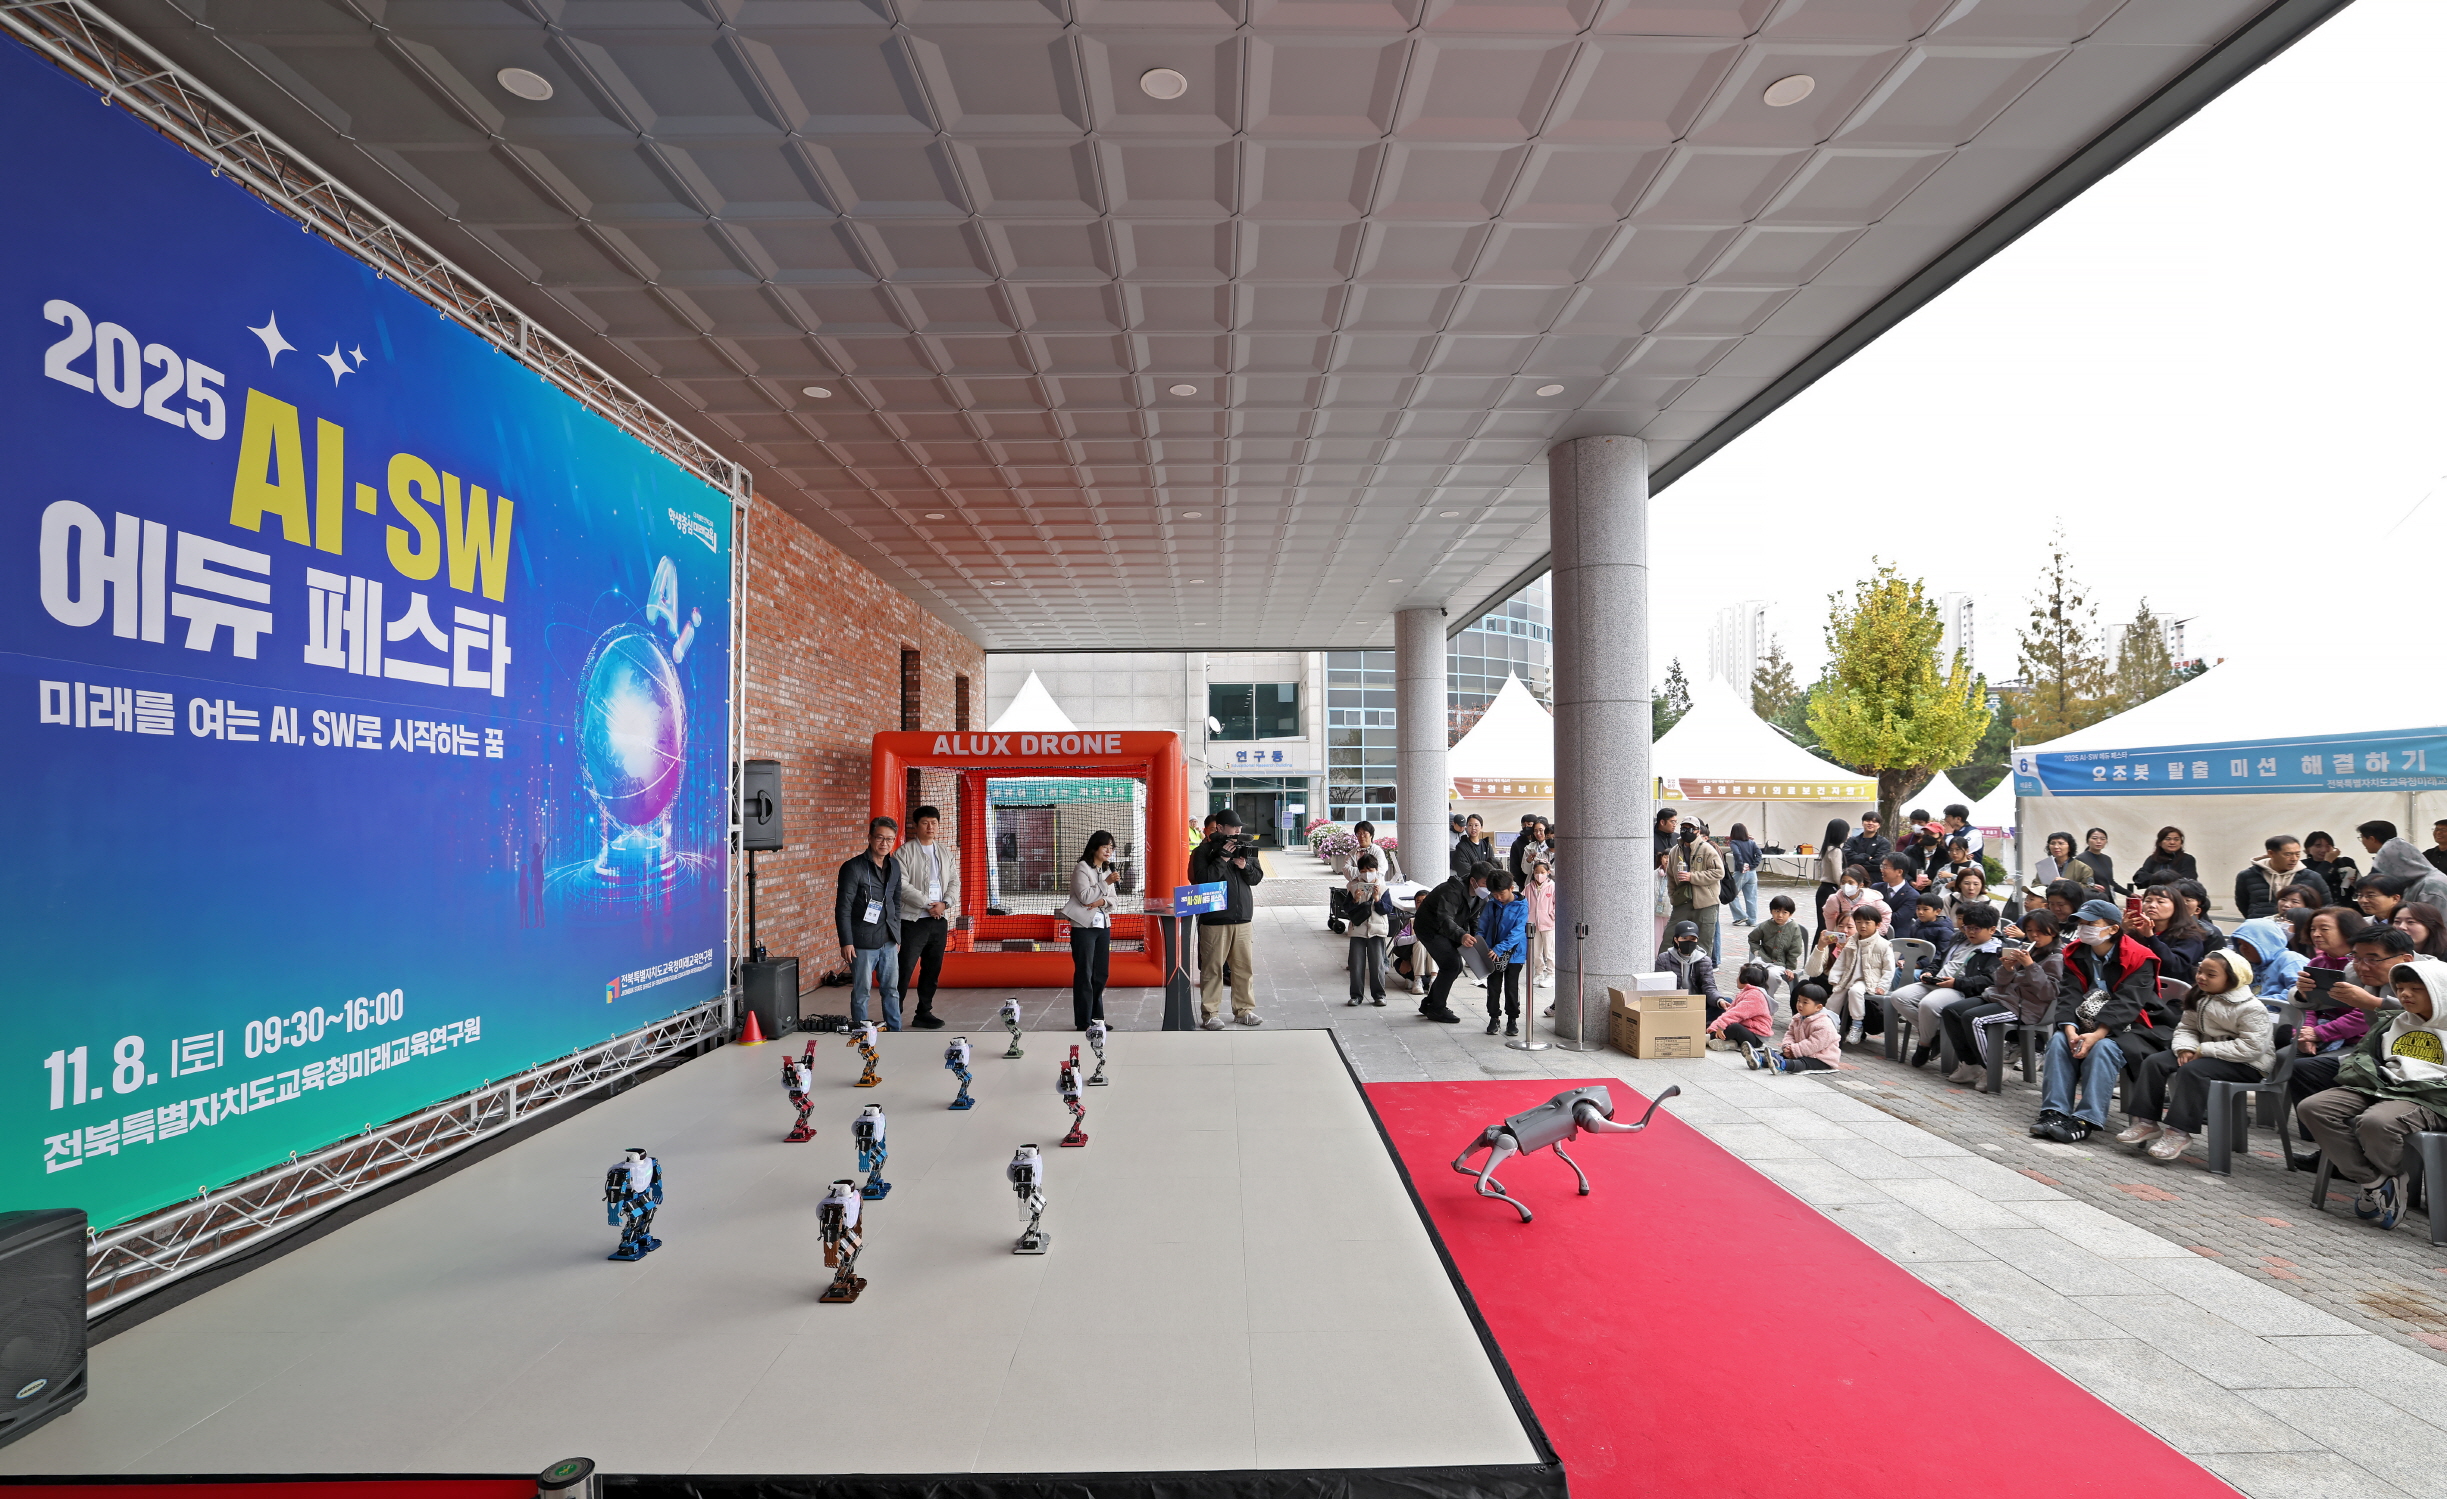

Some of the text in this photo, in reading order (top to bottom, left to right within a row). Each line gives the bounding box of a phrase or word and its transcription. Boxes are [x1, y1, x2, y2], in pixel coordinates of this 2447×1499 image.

[43, 298, 227, 441] 2025
[39, 500, 512, 697] 에듀 페스타
[39, 679, 504, 759] 미래를 여는 AI, SW로 시작하는 꿈
[932, 733, 1122, 756] ALUX DRONE
[1236, 750, 1284, 763] 연구동
[2064, 754, 2079, 762] 2025
[2111, 750, 2128, 759] 페스타
[2020, 758, 2028, 773] 6
[2092, 750, 2427, 782] 오조봇 탈출 미션 해결하기
[621, 948, 712, 988] 전북특별자치도교육청미래교육연구원
[43, 1045, 103, 1111] 11.
[111, 1035, 158, 1095] 8.
[243, 988, 405, 1060] 09:30~16:00
[43, 1015, 481, 1175] 전북특별자치도교육청미래교육연구원
